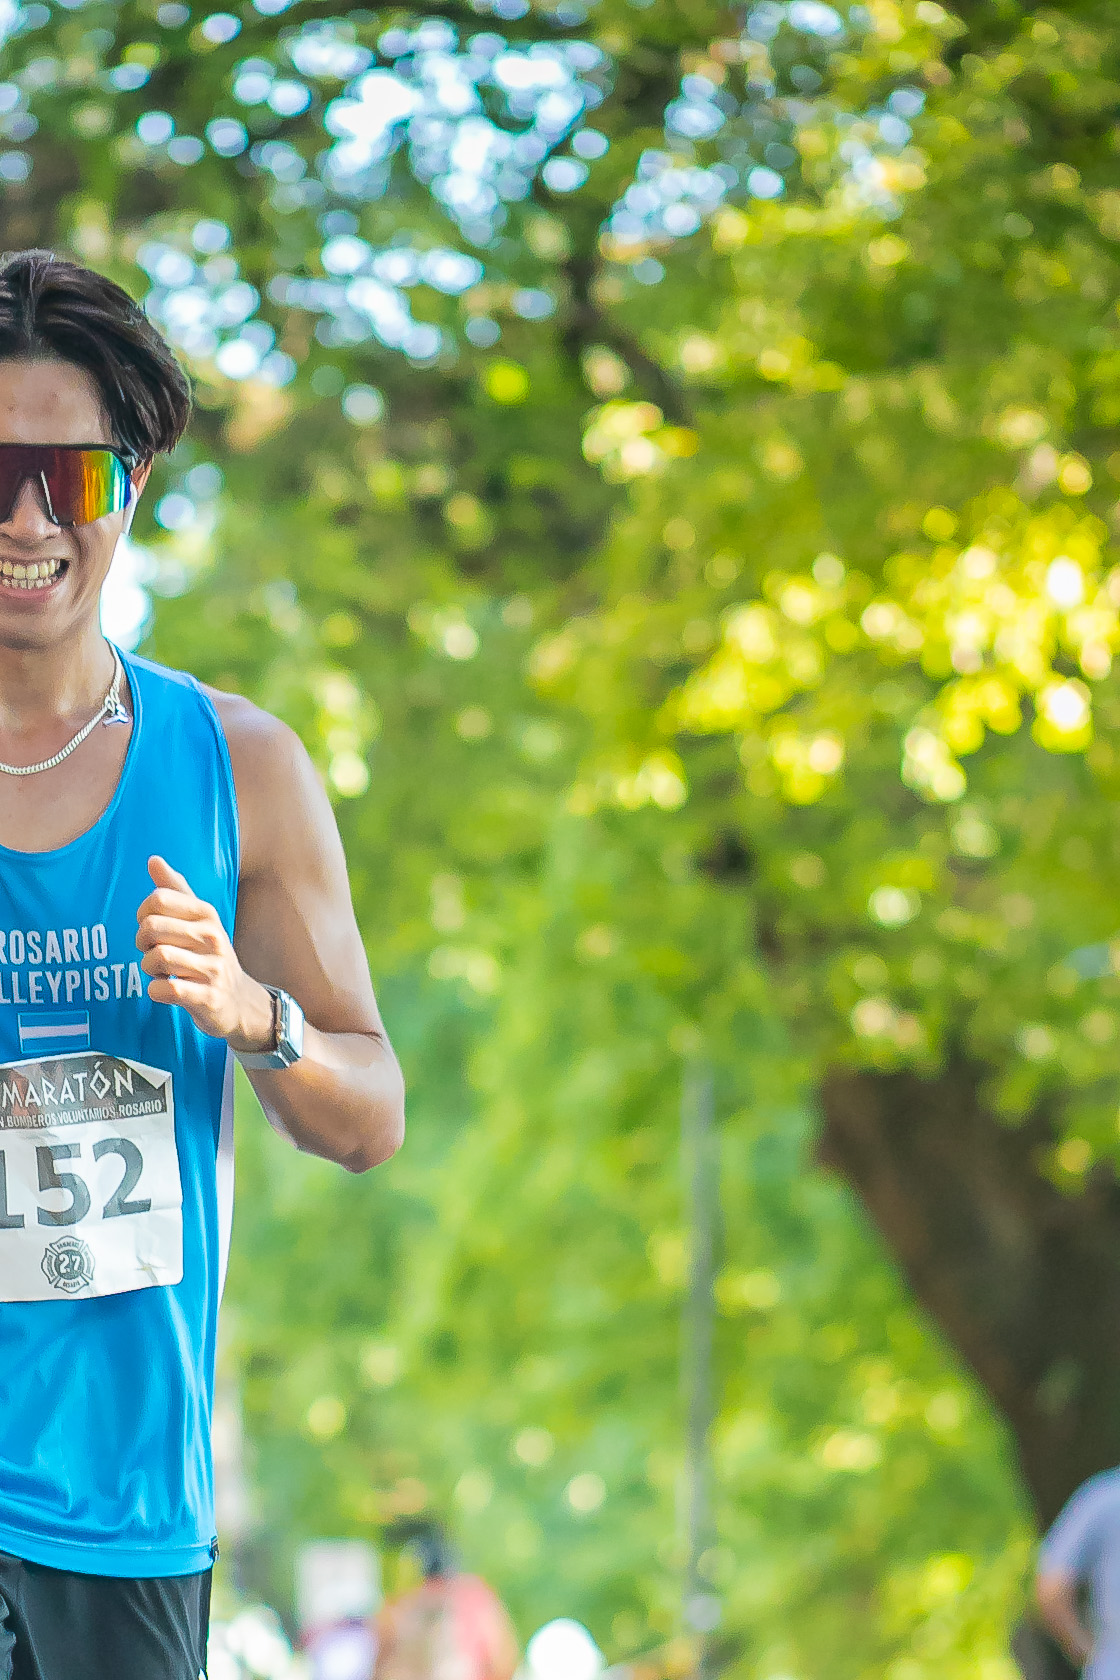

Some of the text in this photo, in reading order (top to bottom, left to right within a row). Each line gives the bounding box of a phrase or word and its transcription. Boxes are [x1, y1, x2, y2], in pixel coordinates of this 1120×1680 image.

[1, 1061, 134, 1109] MARATÓN
[6, 1112, 57, 1128] BOMBEROS
[58, 1106, 117, 1124] VOLUNTARIOS
[118, 1099, 162, 1117] ROSARIO
[58, 1253, 81, 1274] 27
